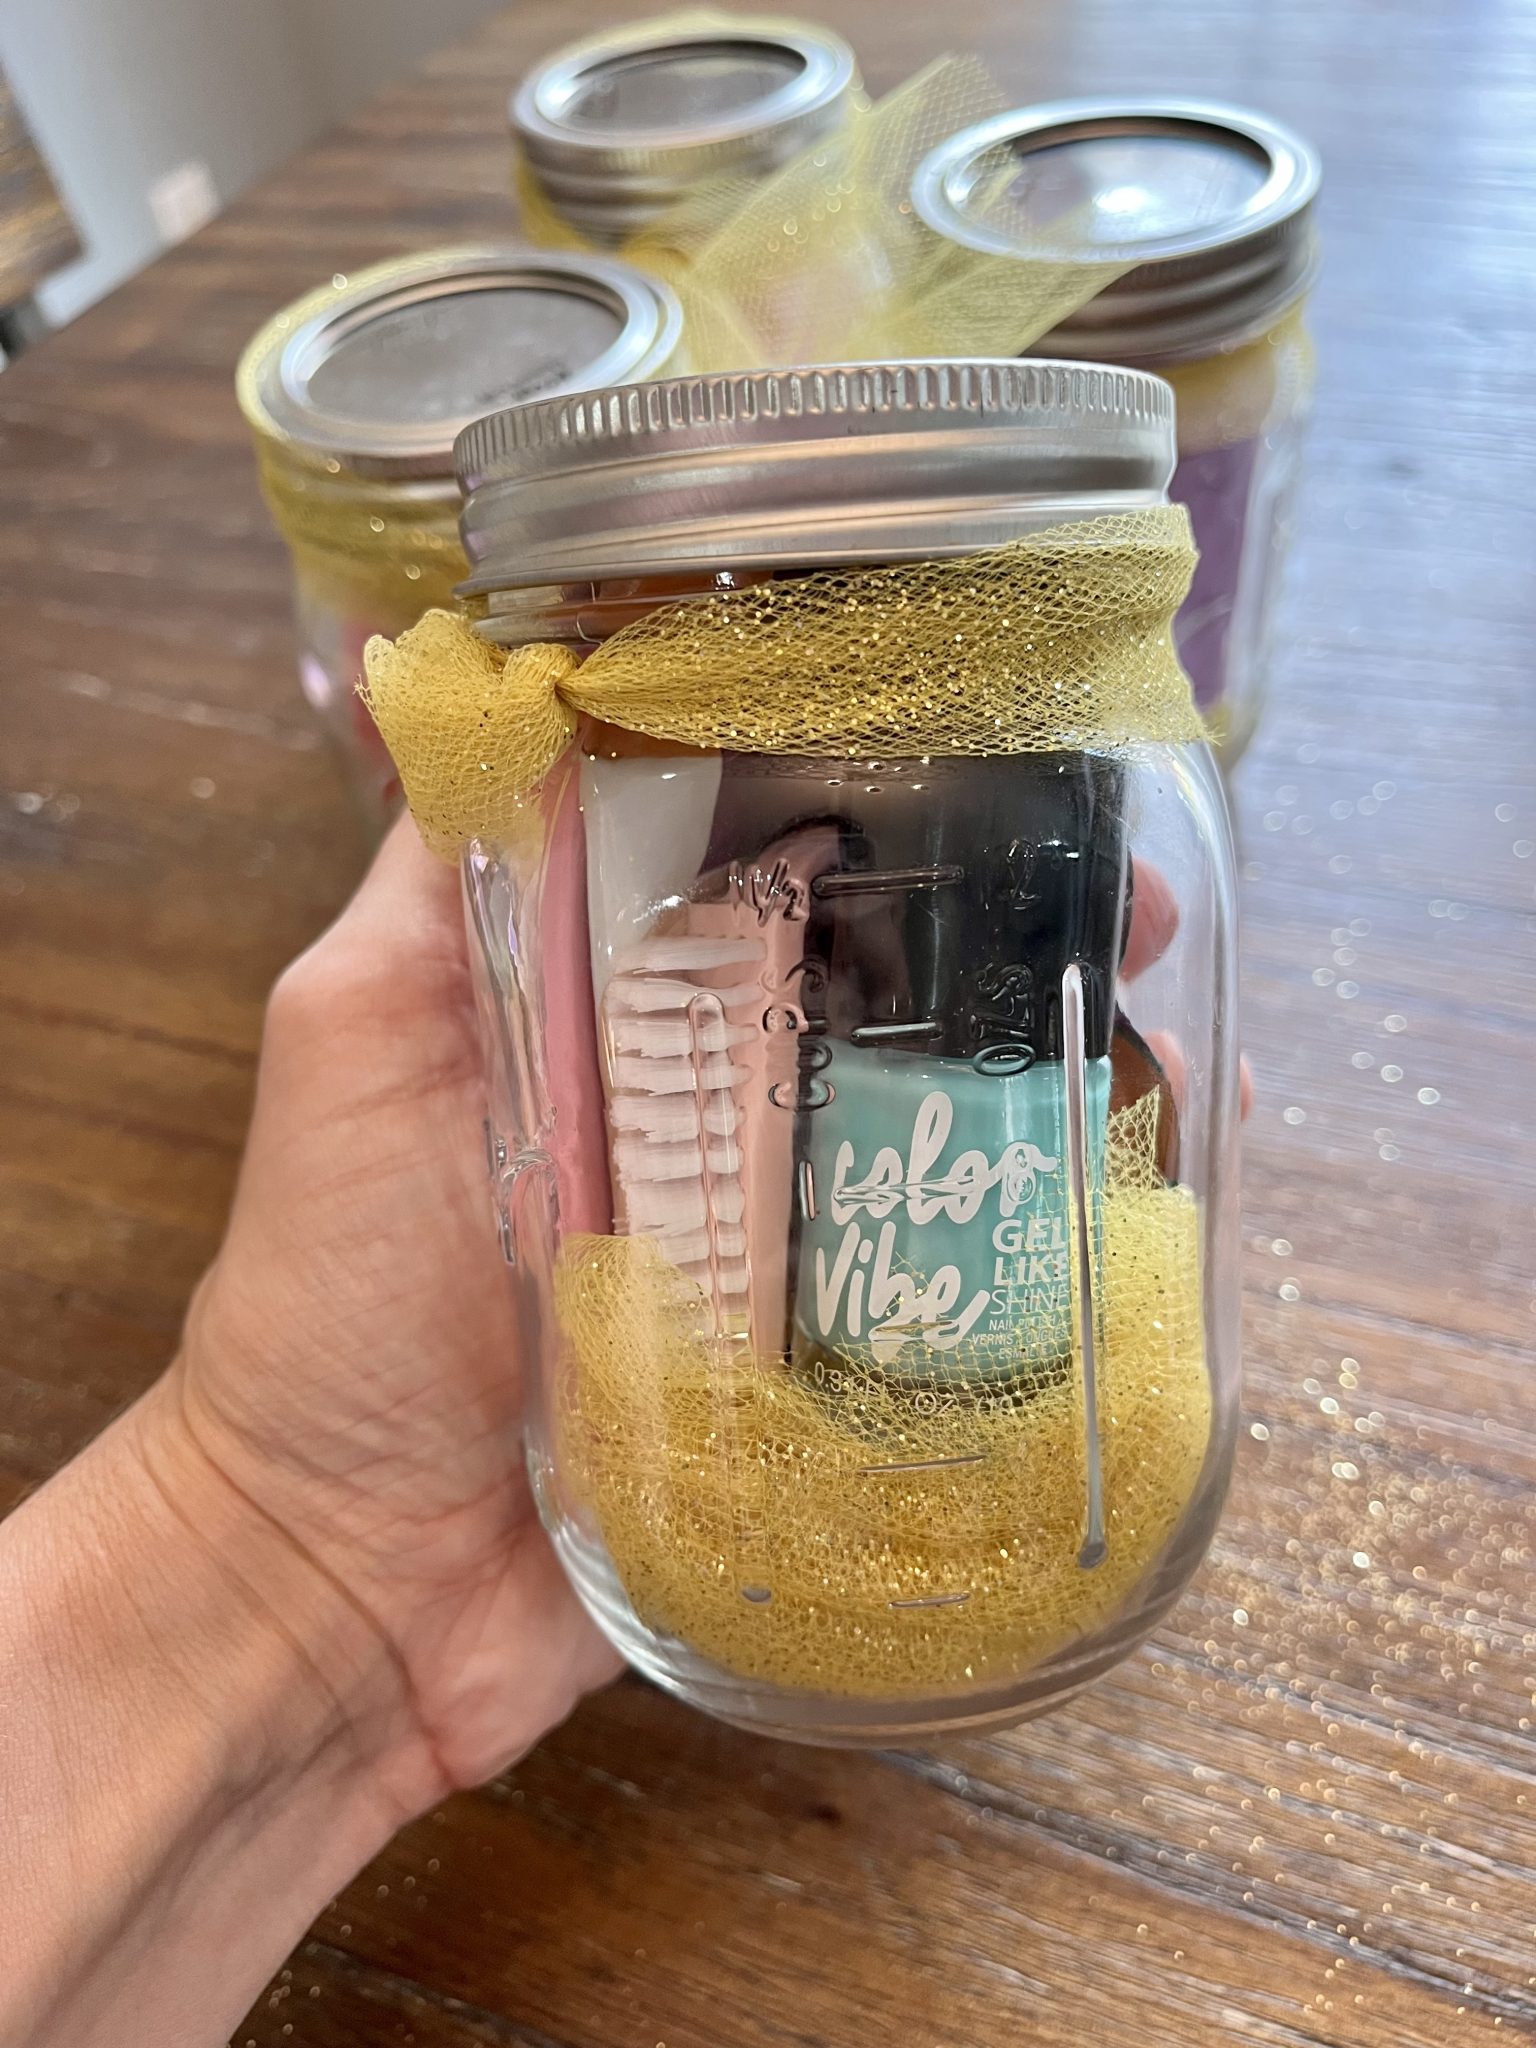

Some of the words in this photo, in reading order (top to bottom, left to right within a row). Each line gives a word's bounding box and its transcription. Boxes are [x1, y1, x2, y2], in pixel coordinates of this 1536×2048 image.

[992, 1217, 1066, 1254] GEL
[993, 1251, 1068, 1286] LIKE
[816, 1221, 990, 1362] Vibe
[990, 1284, 1069, 1315] SHINE
